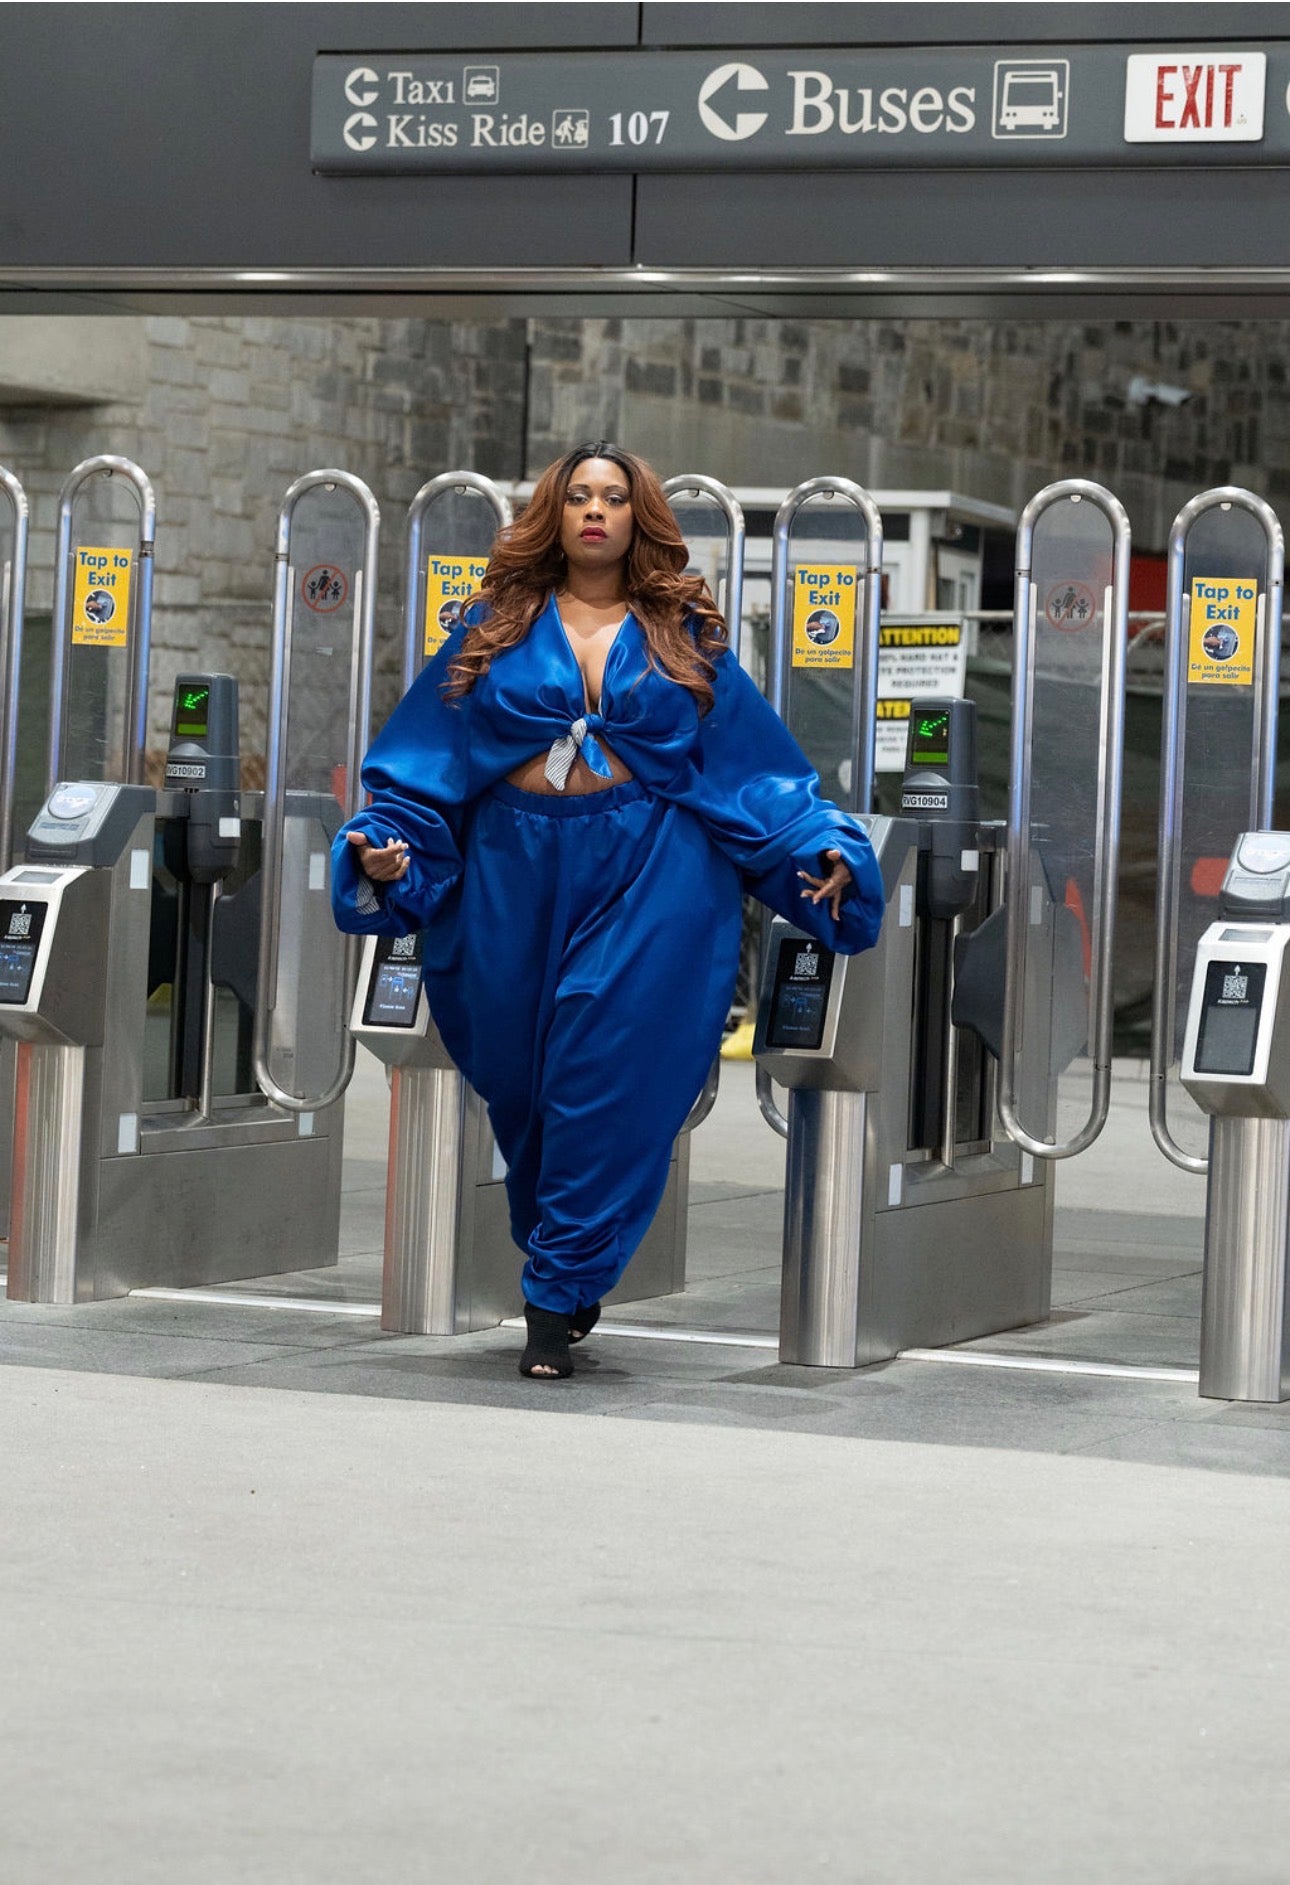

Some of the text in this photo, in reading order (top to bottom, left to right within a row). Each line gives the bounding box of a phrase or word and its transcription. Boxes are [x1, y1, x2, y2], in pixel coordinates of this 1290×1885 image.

[388, 72, 455, 104] Taxi
[1155, 64, 1242, 128] EXIT
[785, 70, 976, 135] Buses
[386, 114, 546, 147] Kiss Ride
[608, 111, 671, 146] 107
[80, 552, 128, 570] Tap to
[432, 561, 486, 579] Tap to
[88, 572, 116, 586] Exit
[798, 570, 853, 588] Tap to
[442, 581, 472, 596] Exit
[1195, 583, 1253, 602] Tap to
[809, 591, 840, 605] Exit
[1206, 604, 1240, 620] Exit
[168, 766, 204, 776] VG10902
